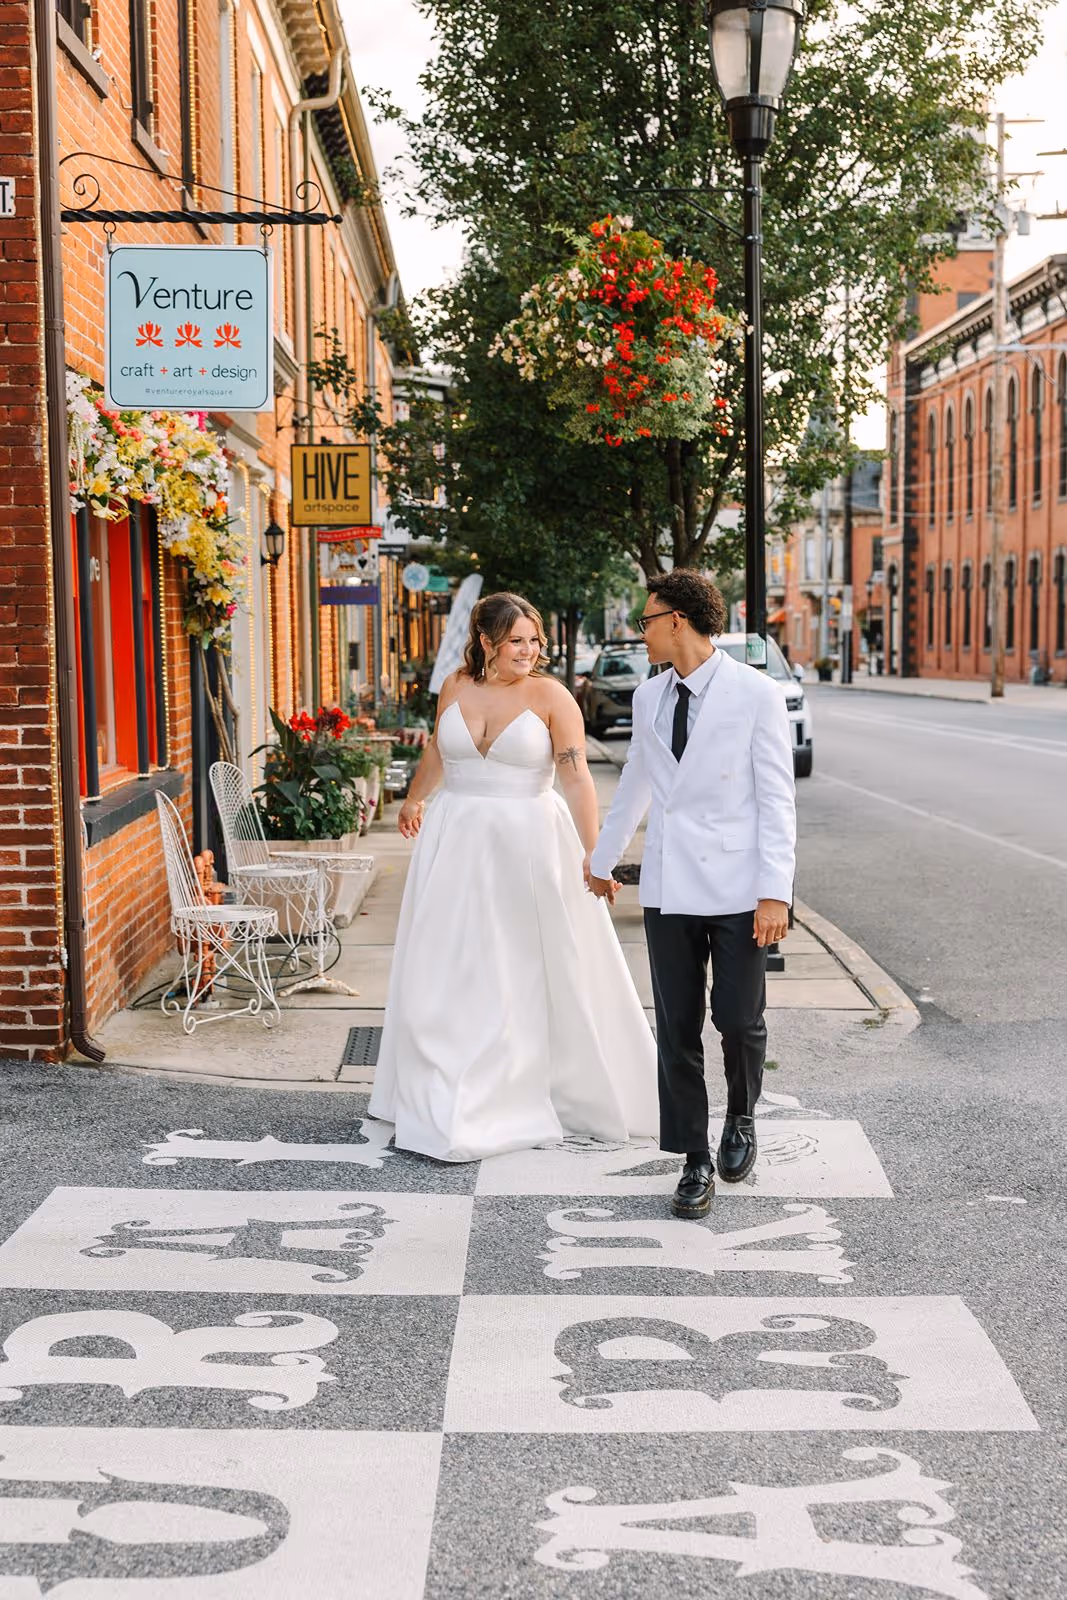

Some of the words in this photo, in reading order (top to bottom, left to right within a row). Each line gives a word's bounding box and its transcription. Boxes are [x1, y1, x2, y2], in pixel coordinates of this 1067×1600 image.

[117, 270, 253, 311] Venture
[120, 362, 154, 377] craft
[173, 365, 193, 378] art
[211, 364, 257, 381] design
[144, 387, 233, 397] #ventureroyalsquare
[302, 452, 360, 500] HIVE
[304, 502, 360, 515] artspace
